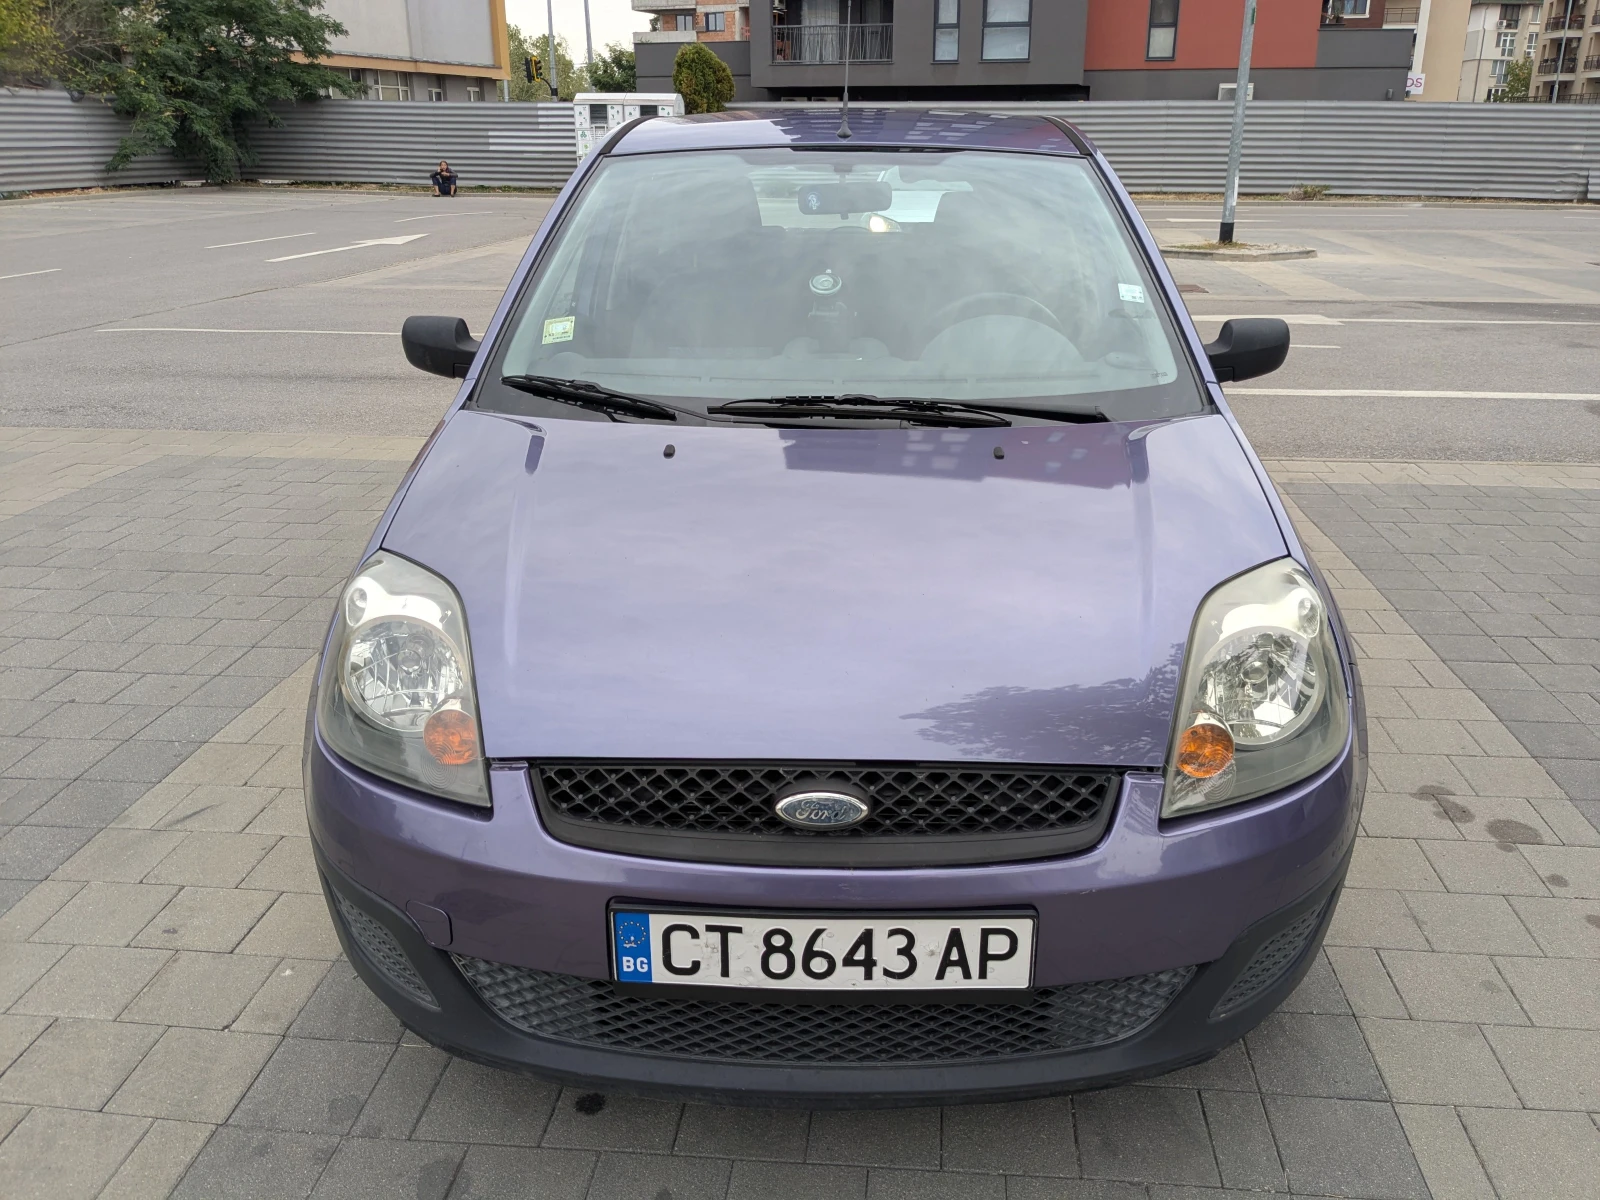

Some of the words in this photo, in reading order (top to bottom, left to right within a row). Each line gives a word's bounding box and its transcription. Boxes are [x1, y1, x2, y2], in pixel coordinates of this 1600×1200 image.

[796, 799, 846, 820] Ford
[661, 923, 743, 978] CT
[760, 927, 918, 981] 8643
[935, 927, 1019, 980] AP
[622, 956, 649, 973] BG
